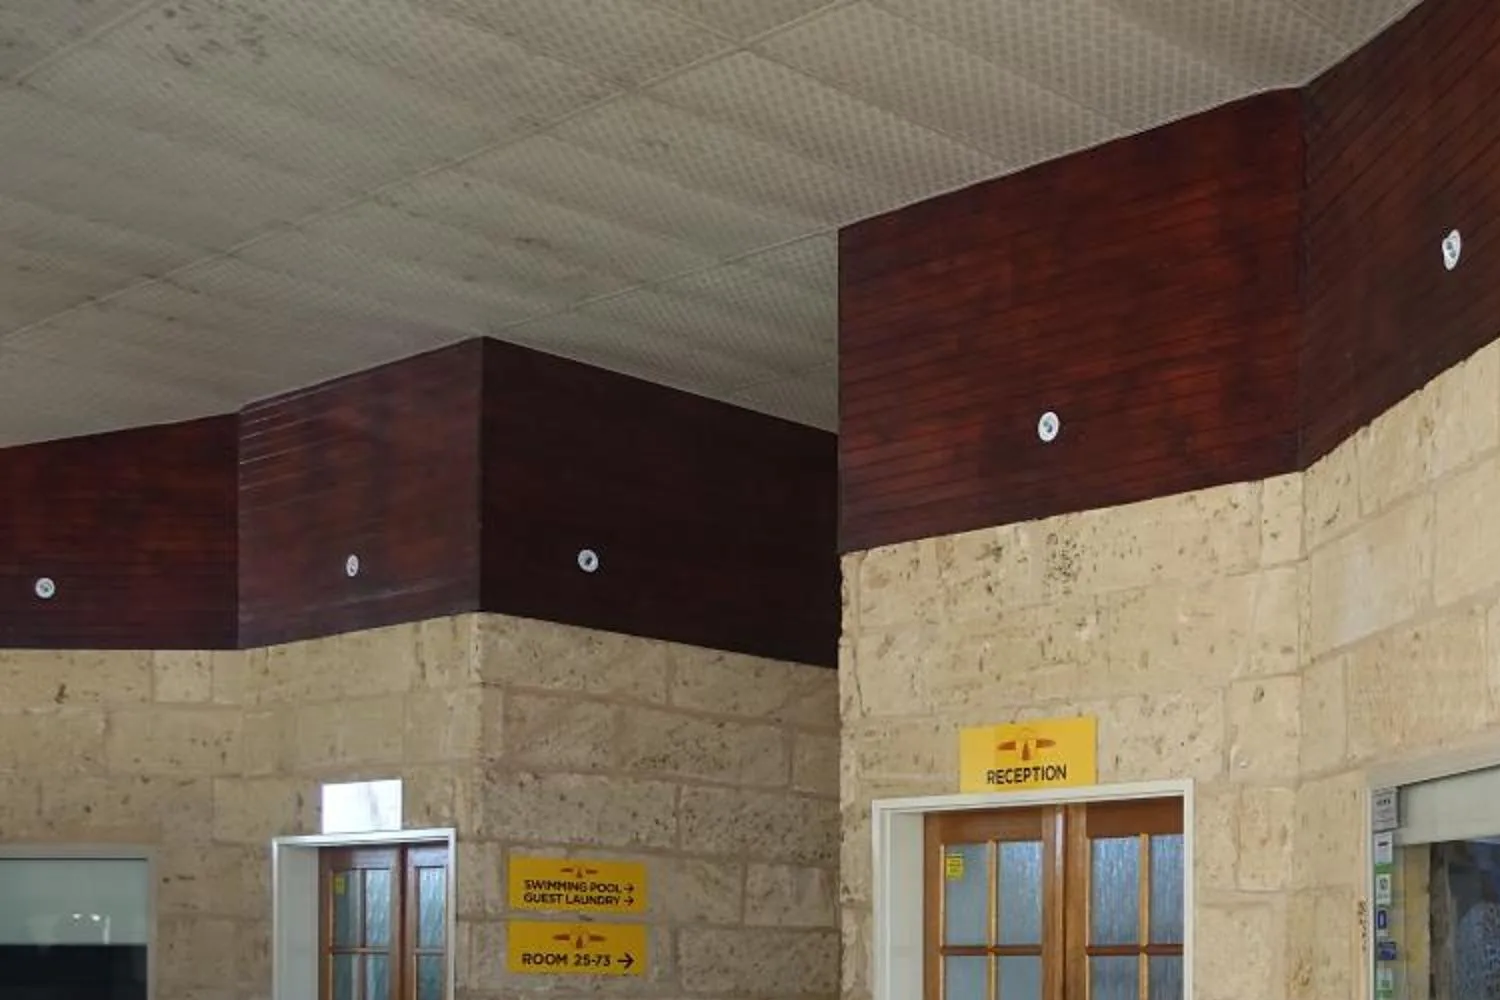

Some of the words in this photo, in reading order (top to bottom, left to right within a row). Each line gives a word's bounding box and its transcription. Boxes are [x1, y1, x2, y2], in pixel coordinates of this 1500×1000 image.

[987, 764, 1067, 785] RECEPTION
[524, 879, 586, 893] SWIMMING
[590, 882, 622, 894] POOL
[524, 893, 564, 904] GUEST
[566, 894, 621, 906] LAUNDRY
[522, 953, 568, 965] ROOM
[574, 954, 611, 967] 25-73
